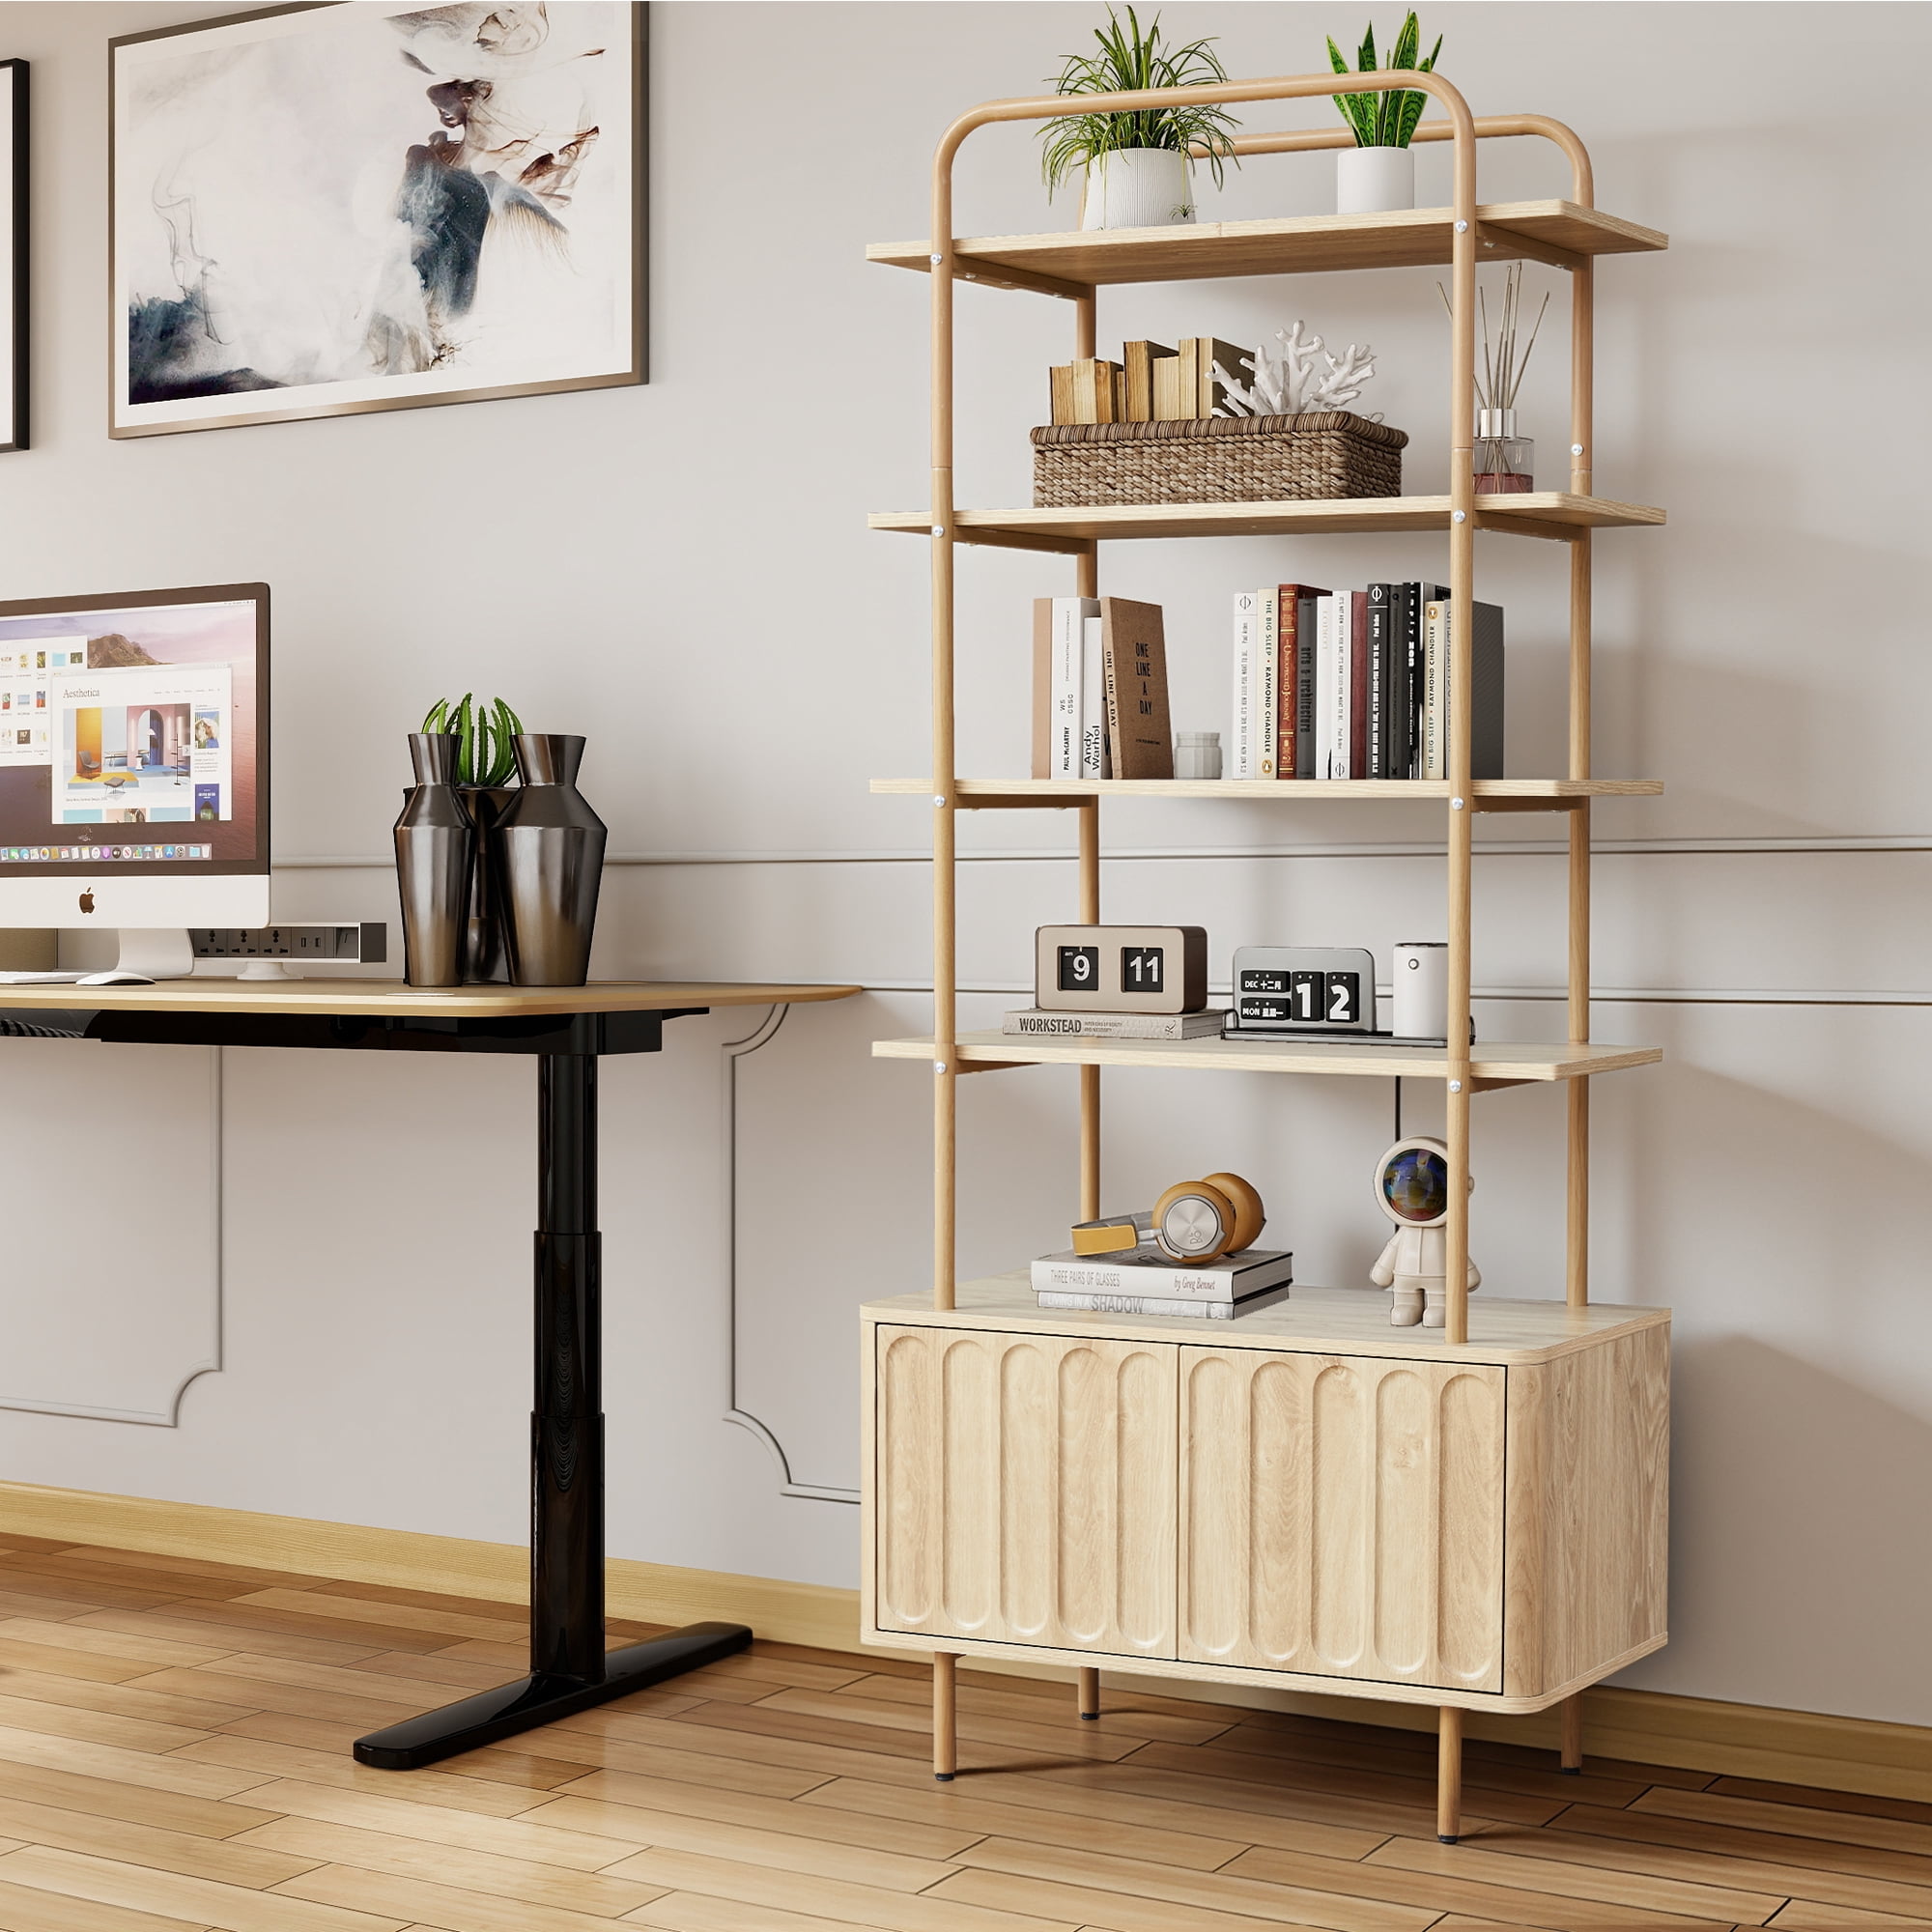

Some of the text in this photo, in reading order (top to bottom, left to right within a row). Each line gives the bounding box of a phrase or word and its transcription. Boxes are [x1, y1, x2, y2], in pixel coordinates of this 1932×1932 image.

[1135, 642, 1149, 658] ONE
[1301, 647, 1312, 664] arts
[1136, 662, 1151, 677] LINE
[63, 688, 100, 698] Aesthetica
[1143, 681, 1148, 696] A
[1139, 700, 1152, 715] DAY
[1281, 689, 1291, 721] JOURNEY
[1301, 679, 1313, 733] architecture
[1083, 731, 1094, 765] Andy
[1073, 955, 1090, 981] 9
[1130, 956, 1159, 982] 11
[1260, 980, 1281, 990] 十二月
[1296, 983, 1350, 1020] 1 2
[1242, 1008, 1260, 1016] MON
[1020, 1018, 1081, 1033] WORKSTEAD
[1051, 1269, 1120, 1287] THREE PAIRS OF GLASSES
[1175, 1276, 1181, 1291] by
[1182, 1276, 1195, 1293] Greg
[1092, 1295, 1144, 1314] SHADOW
